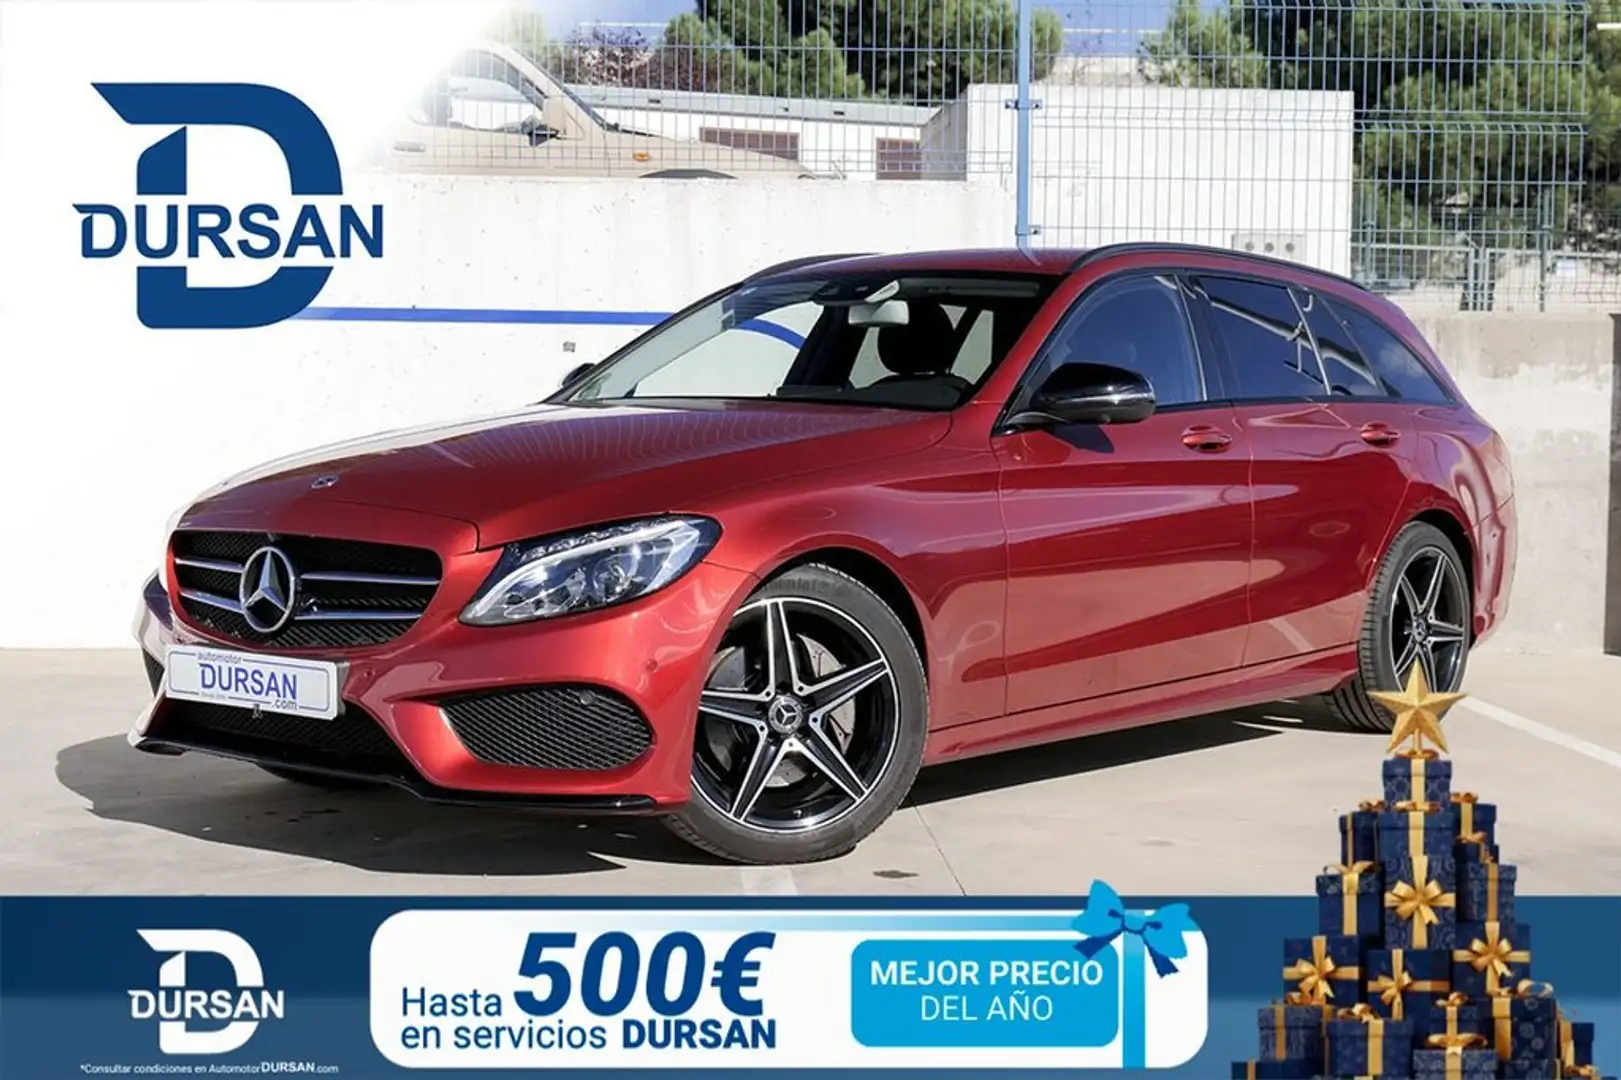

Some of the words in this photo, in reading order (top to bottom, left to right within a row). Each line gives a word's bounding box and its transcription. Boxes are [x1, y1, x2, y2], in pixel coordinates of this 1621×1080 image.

[197, 651, 243, 664] automotor
[199, 663, 297, 700] DURSAN
[271, 698, 298, 711] .com
